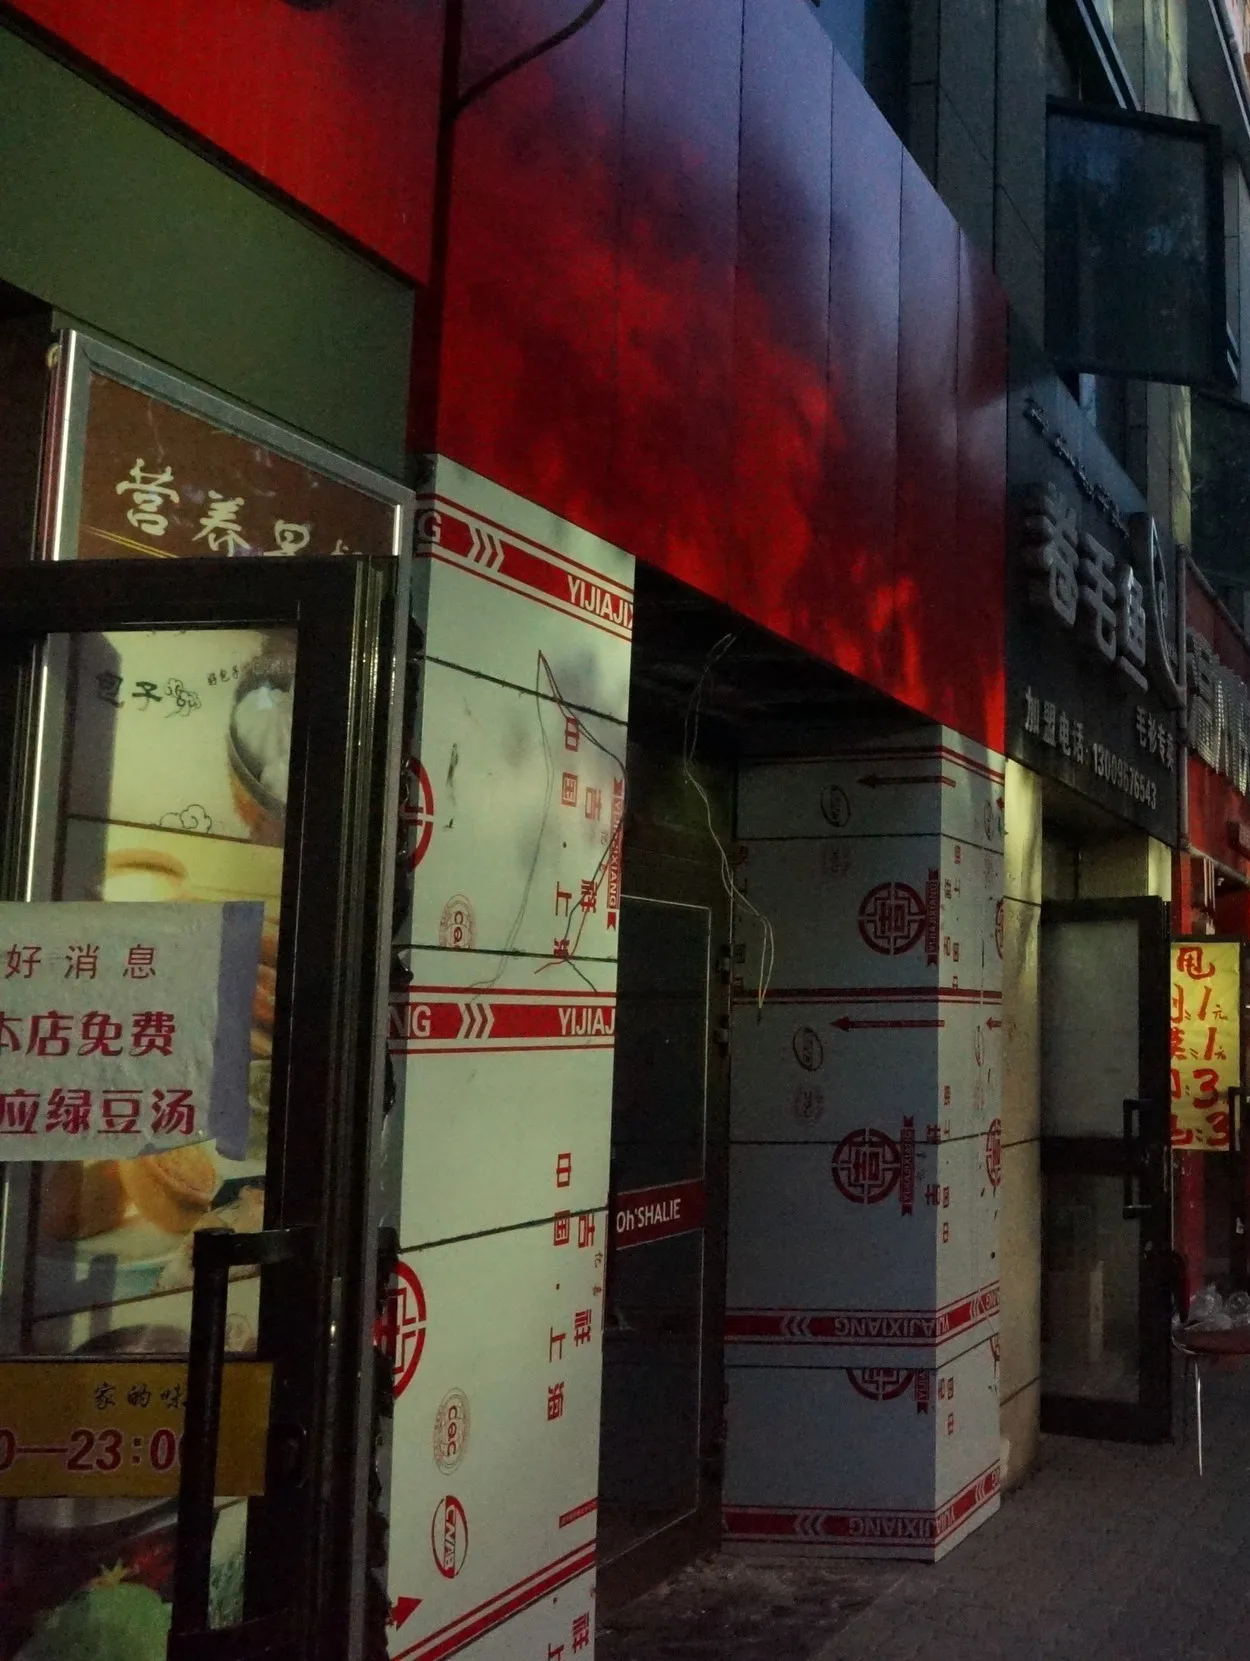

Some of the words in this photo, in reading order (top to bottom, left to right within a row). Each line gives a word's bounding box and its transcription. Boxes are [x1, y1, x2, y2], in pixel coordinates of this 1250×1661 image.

[115, 457, 364, 558] 营养早
[5, 944, 156, 980] 好消息
